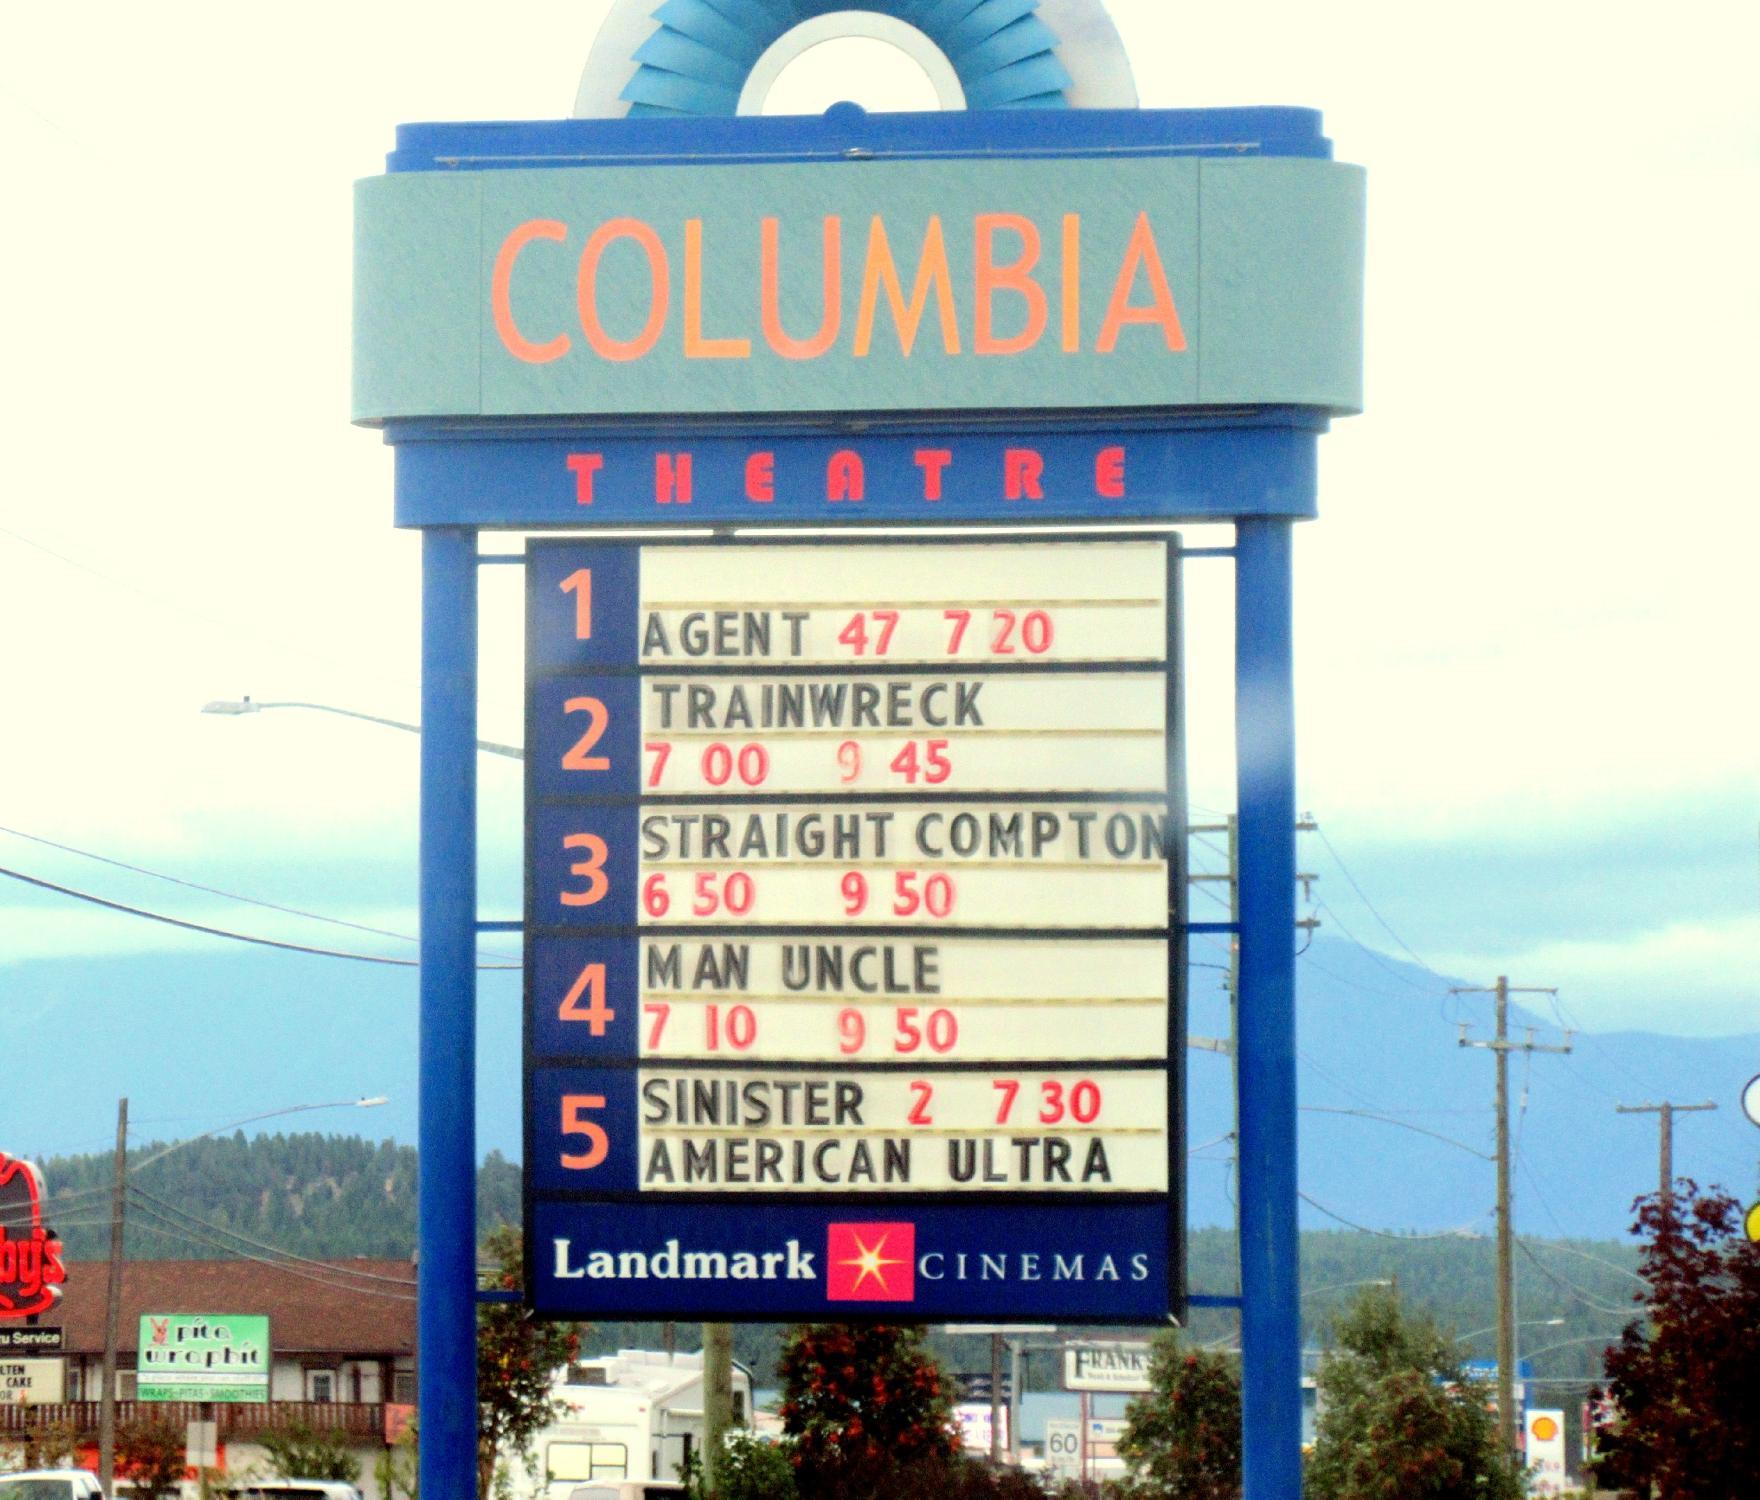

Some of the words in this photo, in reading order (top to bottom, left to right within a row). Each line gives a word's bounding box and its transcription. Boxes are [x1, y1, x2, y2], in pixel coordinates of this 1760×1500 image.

[491, 211, 1188, 363] COLUMBIA
[566, 447, 1126, 505] THEATRE
[559, 568, 591, 640] 1
[642, 609, 810, 658] AGENT
[838, 611, 900, 656] 47
[942, 610, 971, 656] 7
[991, 609, 1054, 655] 20
[652, 681, 985, 730] TRAINWRECK
[560, 697, 611, 771] 2
[644, 742, 672, 787] 7
[701, 741, 770, 787] 00
[837, 741, 863, 784] 9
[890, 740, 952, 784] 45
[641, 812, 894, 862] STRAIGHT
[915, 811, 1166, 860] COMPTON
[559, 833, 610, 906] 3
[642, 873, 670, 918] 6
[692, 871, 757, 917] 50
[840, 871, 869, 917] 9
[893, 871, 956, 919] 50
[648, 945, 750, 991] MAN
[781, 945, 941, 993] UNCLE
[558, 963, 615, 1037] 4
[643, 1004, 672, 1050] 7
[705, 1004, 757, 1051] 10
[839, 1008, 866, 1054] 9
[894, 1009, 958, 1054] 50
[642, 1078, 864, 1127] SINISTER
[907, 1083, 933, 1125] 2
[992, 1080, 1020, 1125] 7
[1038, 1080, 1102, 1125] 30
[559, 1095, 610, 1171] 5
[644, 1138, 911, 1184] AMERICAN
[948, 1137, 1112, 1184] ULTRA
[552, 1238, 818, 1281] Landmark
[919, 1252, 1150, 1283] CINEMAS
[12, 1331, 60, 1345] Service
[177, 1316, 231, 1343] pita
[6, 1376, 32, 1388] CAKE
[1050, 1433, 1078, 1453] 60
